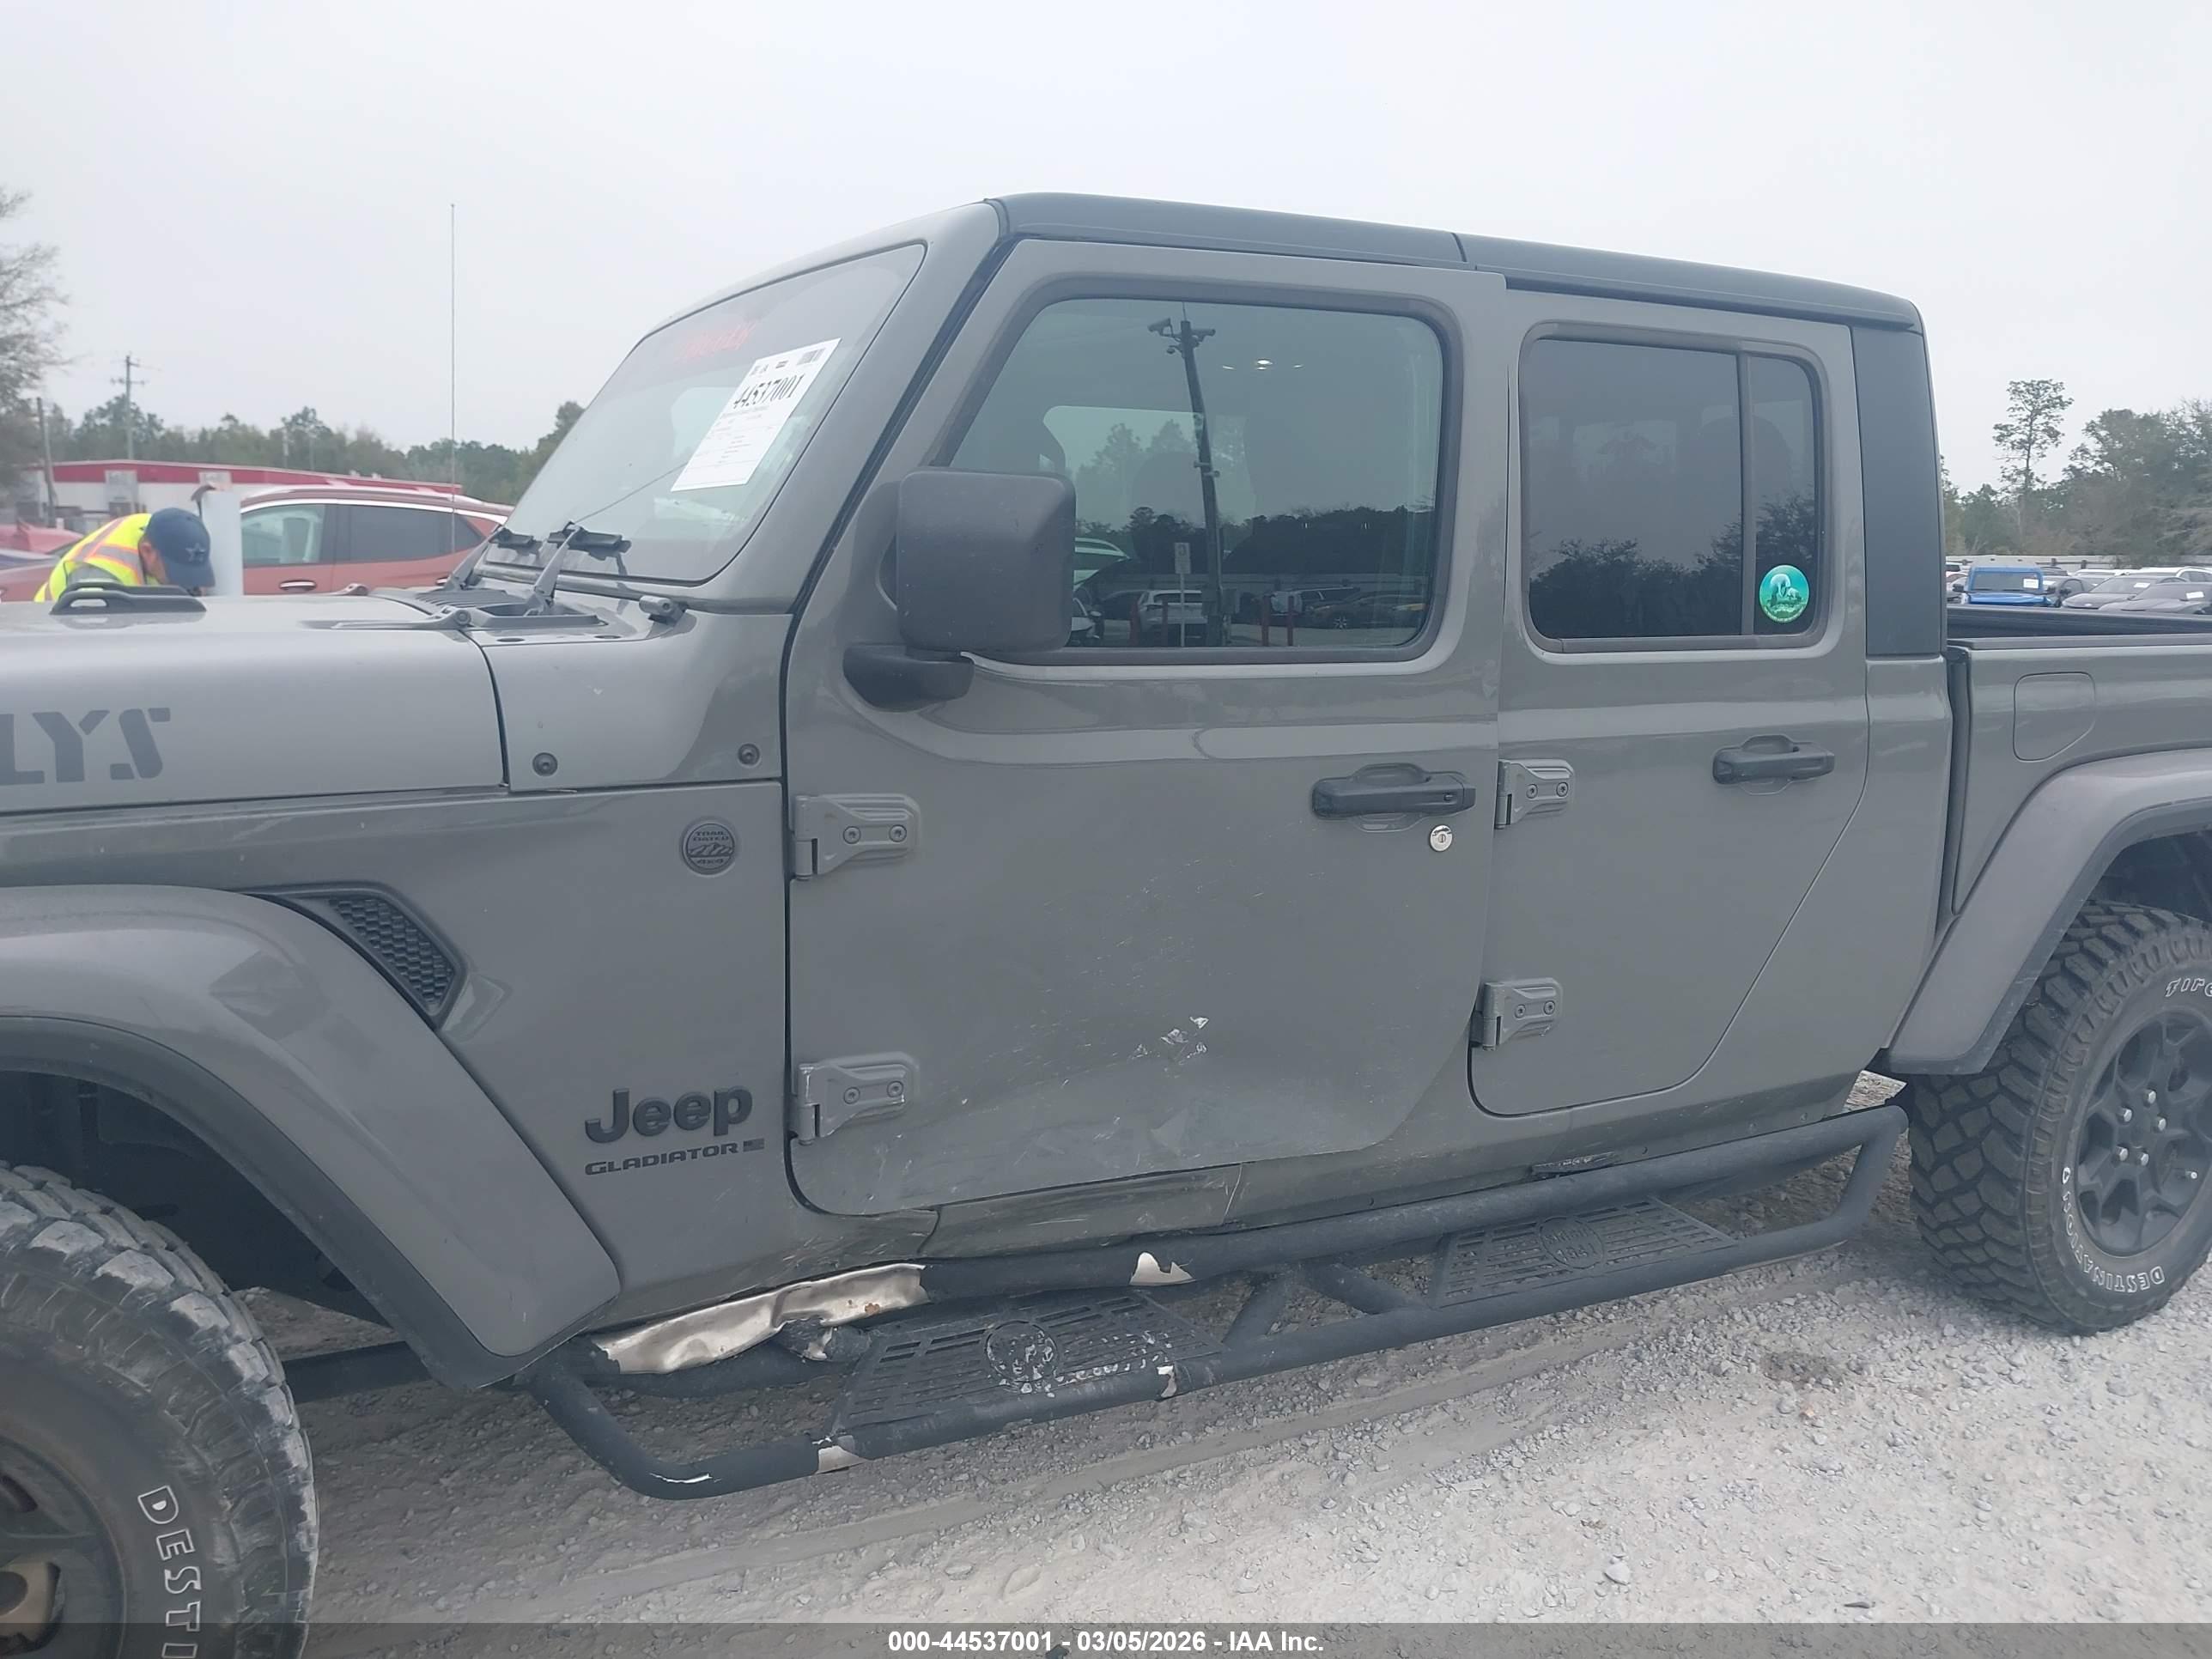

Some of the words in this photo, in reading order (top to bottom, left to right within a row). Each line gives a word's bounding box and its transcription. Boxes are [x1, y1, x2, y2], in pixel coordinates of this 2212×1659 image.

[733, 374, 805, 409] 44537001
[585, 1086, 752, 1143] Jeep
[585, 1142, 739, 1176] GLADIATOR
